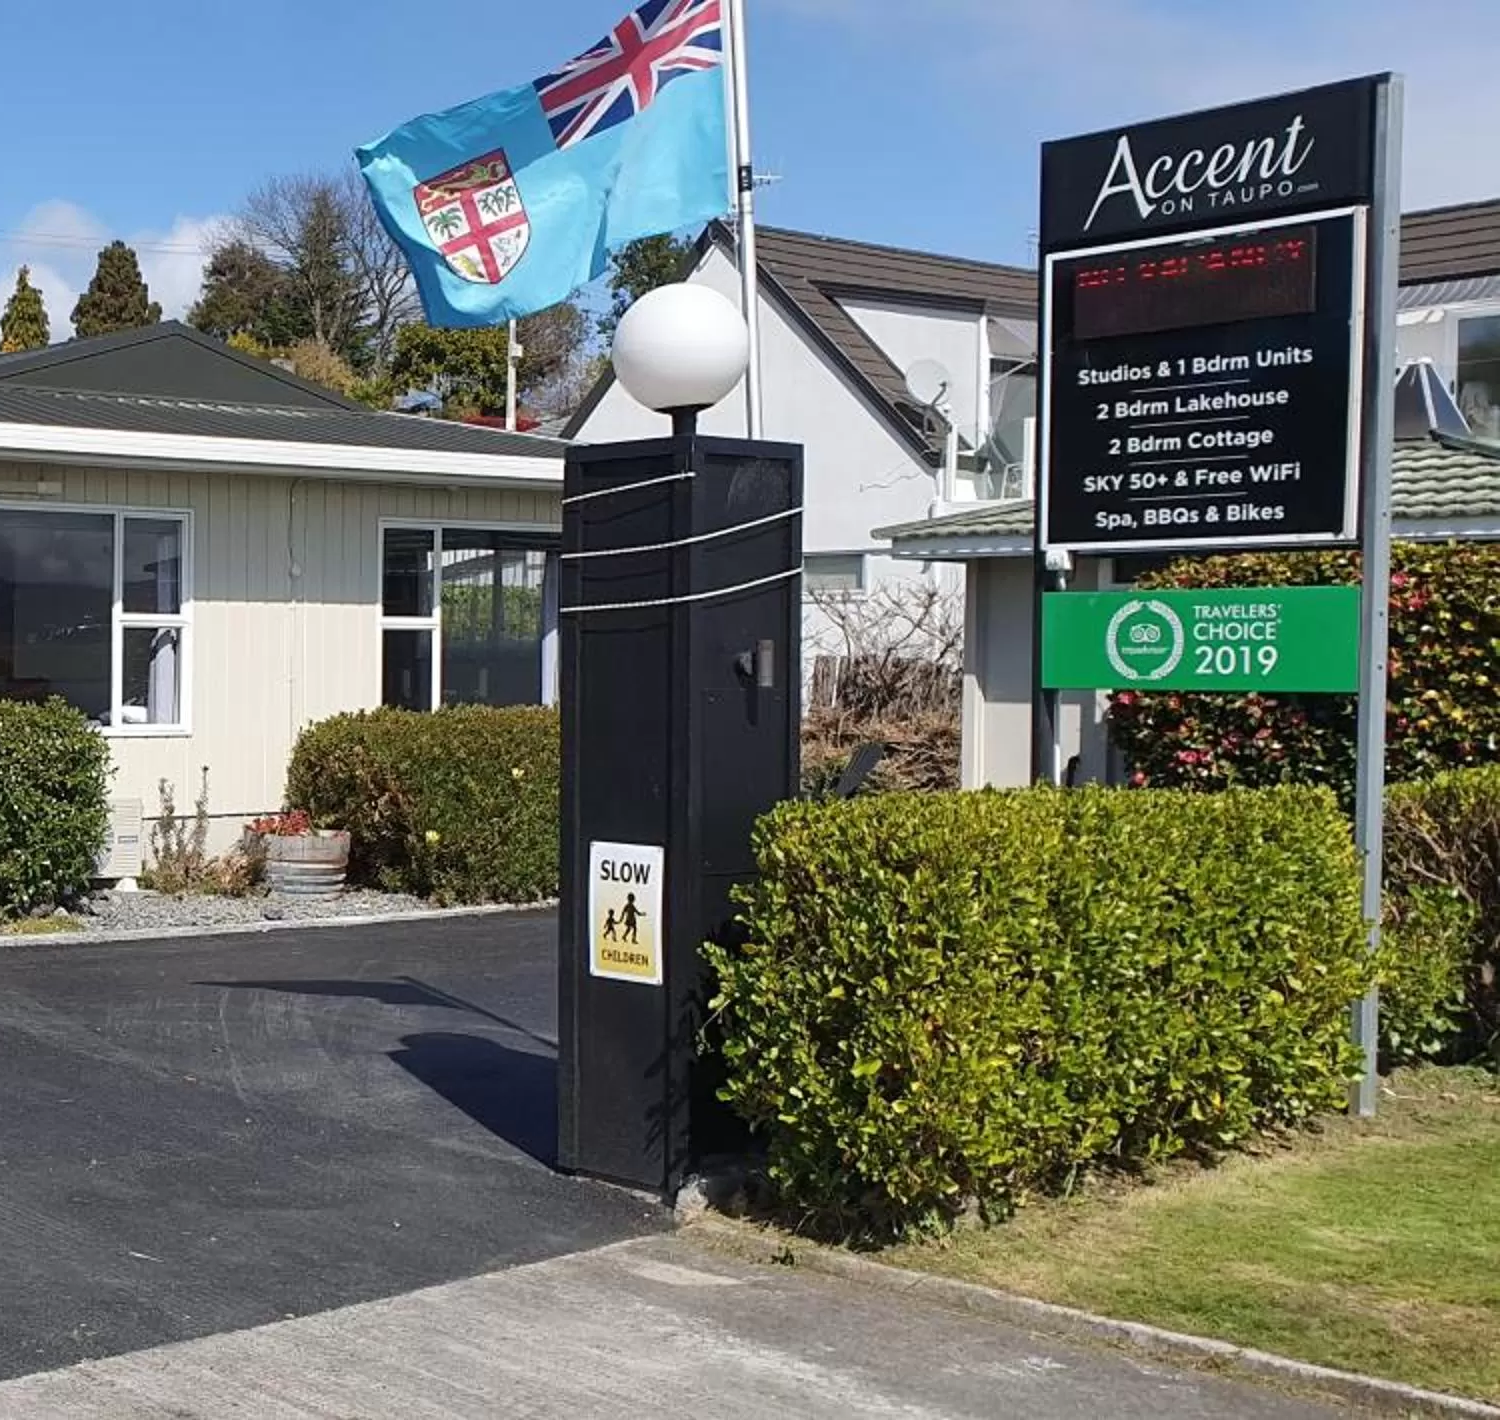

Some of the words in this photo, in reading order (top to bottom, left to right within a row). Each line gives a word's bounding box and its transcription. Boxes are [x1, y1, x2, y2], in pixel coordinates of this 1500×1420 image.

[1083, 115, 1315, 232] Accent
[1160, 198, 1194, 216] ON
[1207, 180, 1294, 209] TAUPO
[1078, 364, 1151, 386] Studios
[1157, 361, 1171, 378] &
[1177, 359, 1186, 375] 1
[1192, 352, 1249, 374] Bdrm
[1257, 346, 1313, 368] Units
[1096, 403, 1109, 420] 2
[1115, 398, 1169, 418] Bdrm
[1175, 388, 1289, 413] Lakehouse
[1108, 438, 1121, 456] 2
[1127, 435, 1181, 454] Bdrm
[1187, 428, 1274, 450] Cottage
[1083, 474, 1124, 493] SKY
[1129, 472, 1169, 490] 50+
[1174, 470, 1189, 487] &
[1195, 468, 1243, 486] Free
[1249, 462, 1301, 483] WiFi
[1095, 511, 1138, 530] Spa,
[1143, 507, 1200, 526] BBQs
[1205, 505, 1220, 523] &
[1227, 502, 1286, 521] Bikes
[1193, 621, 1276, 641] CHOICE
[1195, 645, 1278, 676] 2019
[600, 859, 650, 885] SLOW
[601, 949, 649, 967] CHILDREN
